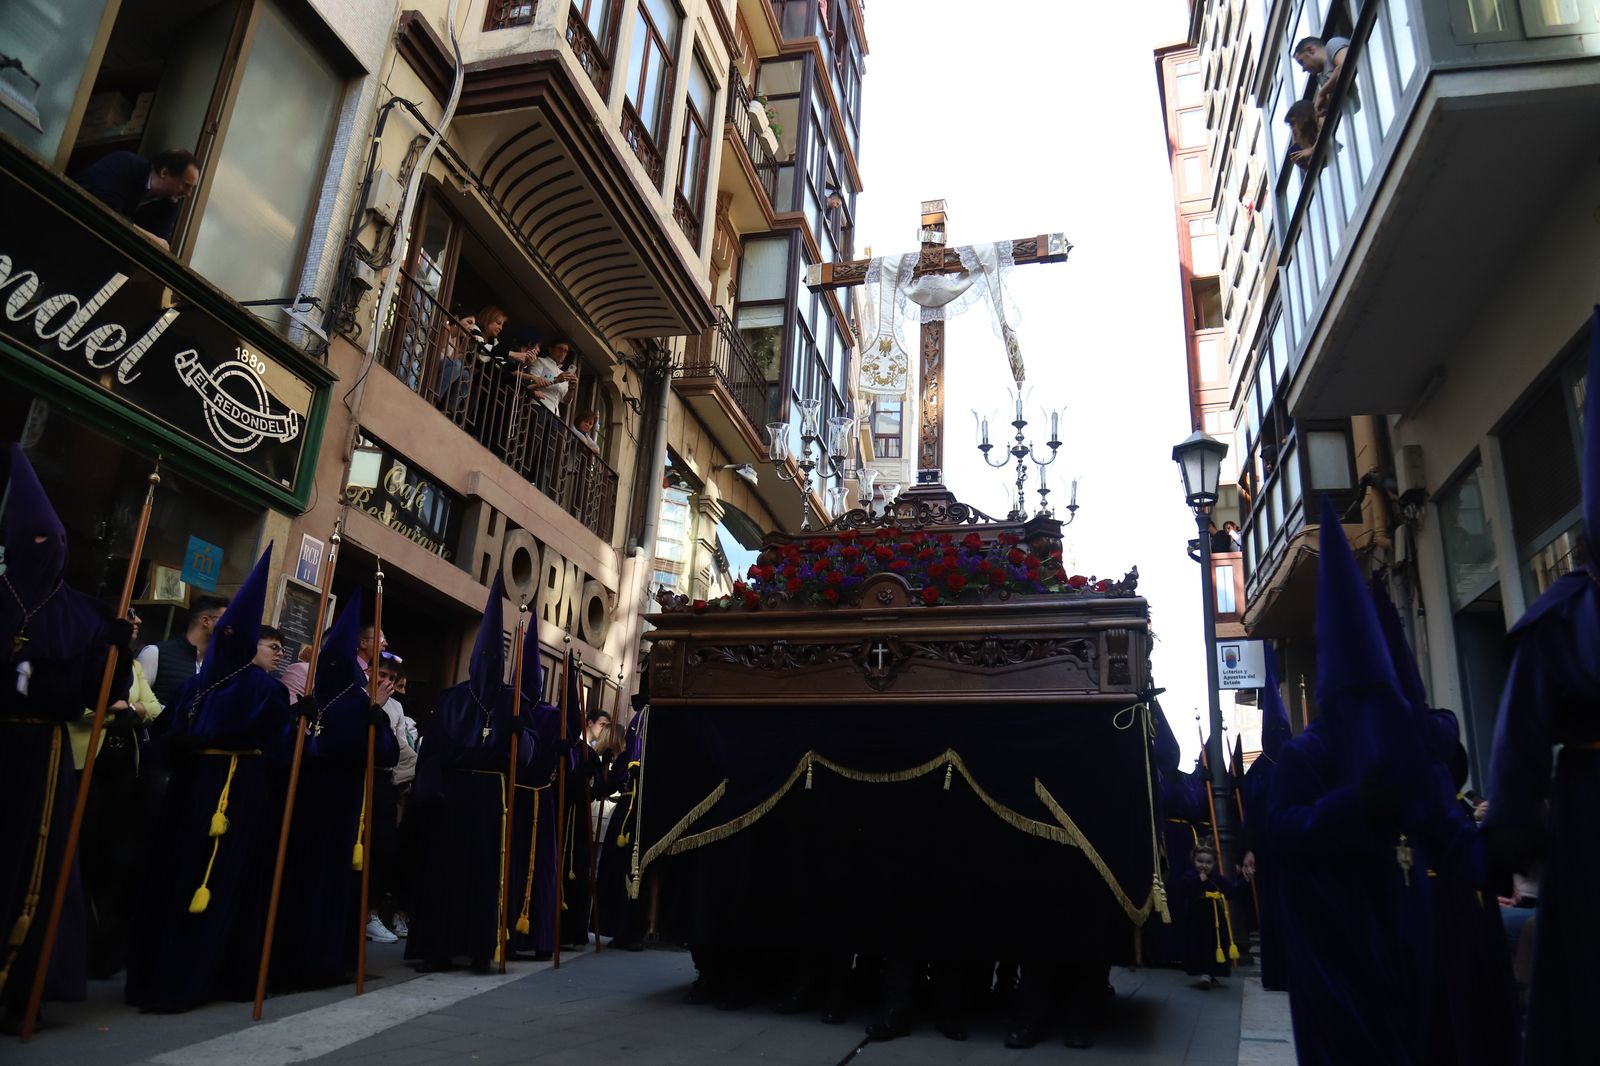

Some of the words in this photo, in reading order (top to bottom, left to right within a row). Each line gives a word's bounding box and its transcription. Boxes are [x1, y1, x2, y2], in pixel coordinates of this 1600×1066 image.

[235, 346, 266, 375] 1880
[193, 372, 210, 394] EL
[213, 392, 284, 434] REDONDEL
[383, 464, 429, 512] Café
[345, 482, 452, 560] Restaurante
[302, 544, 320, 565] RCB
[472, 500, 612, 650] HORNO
